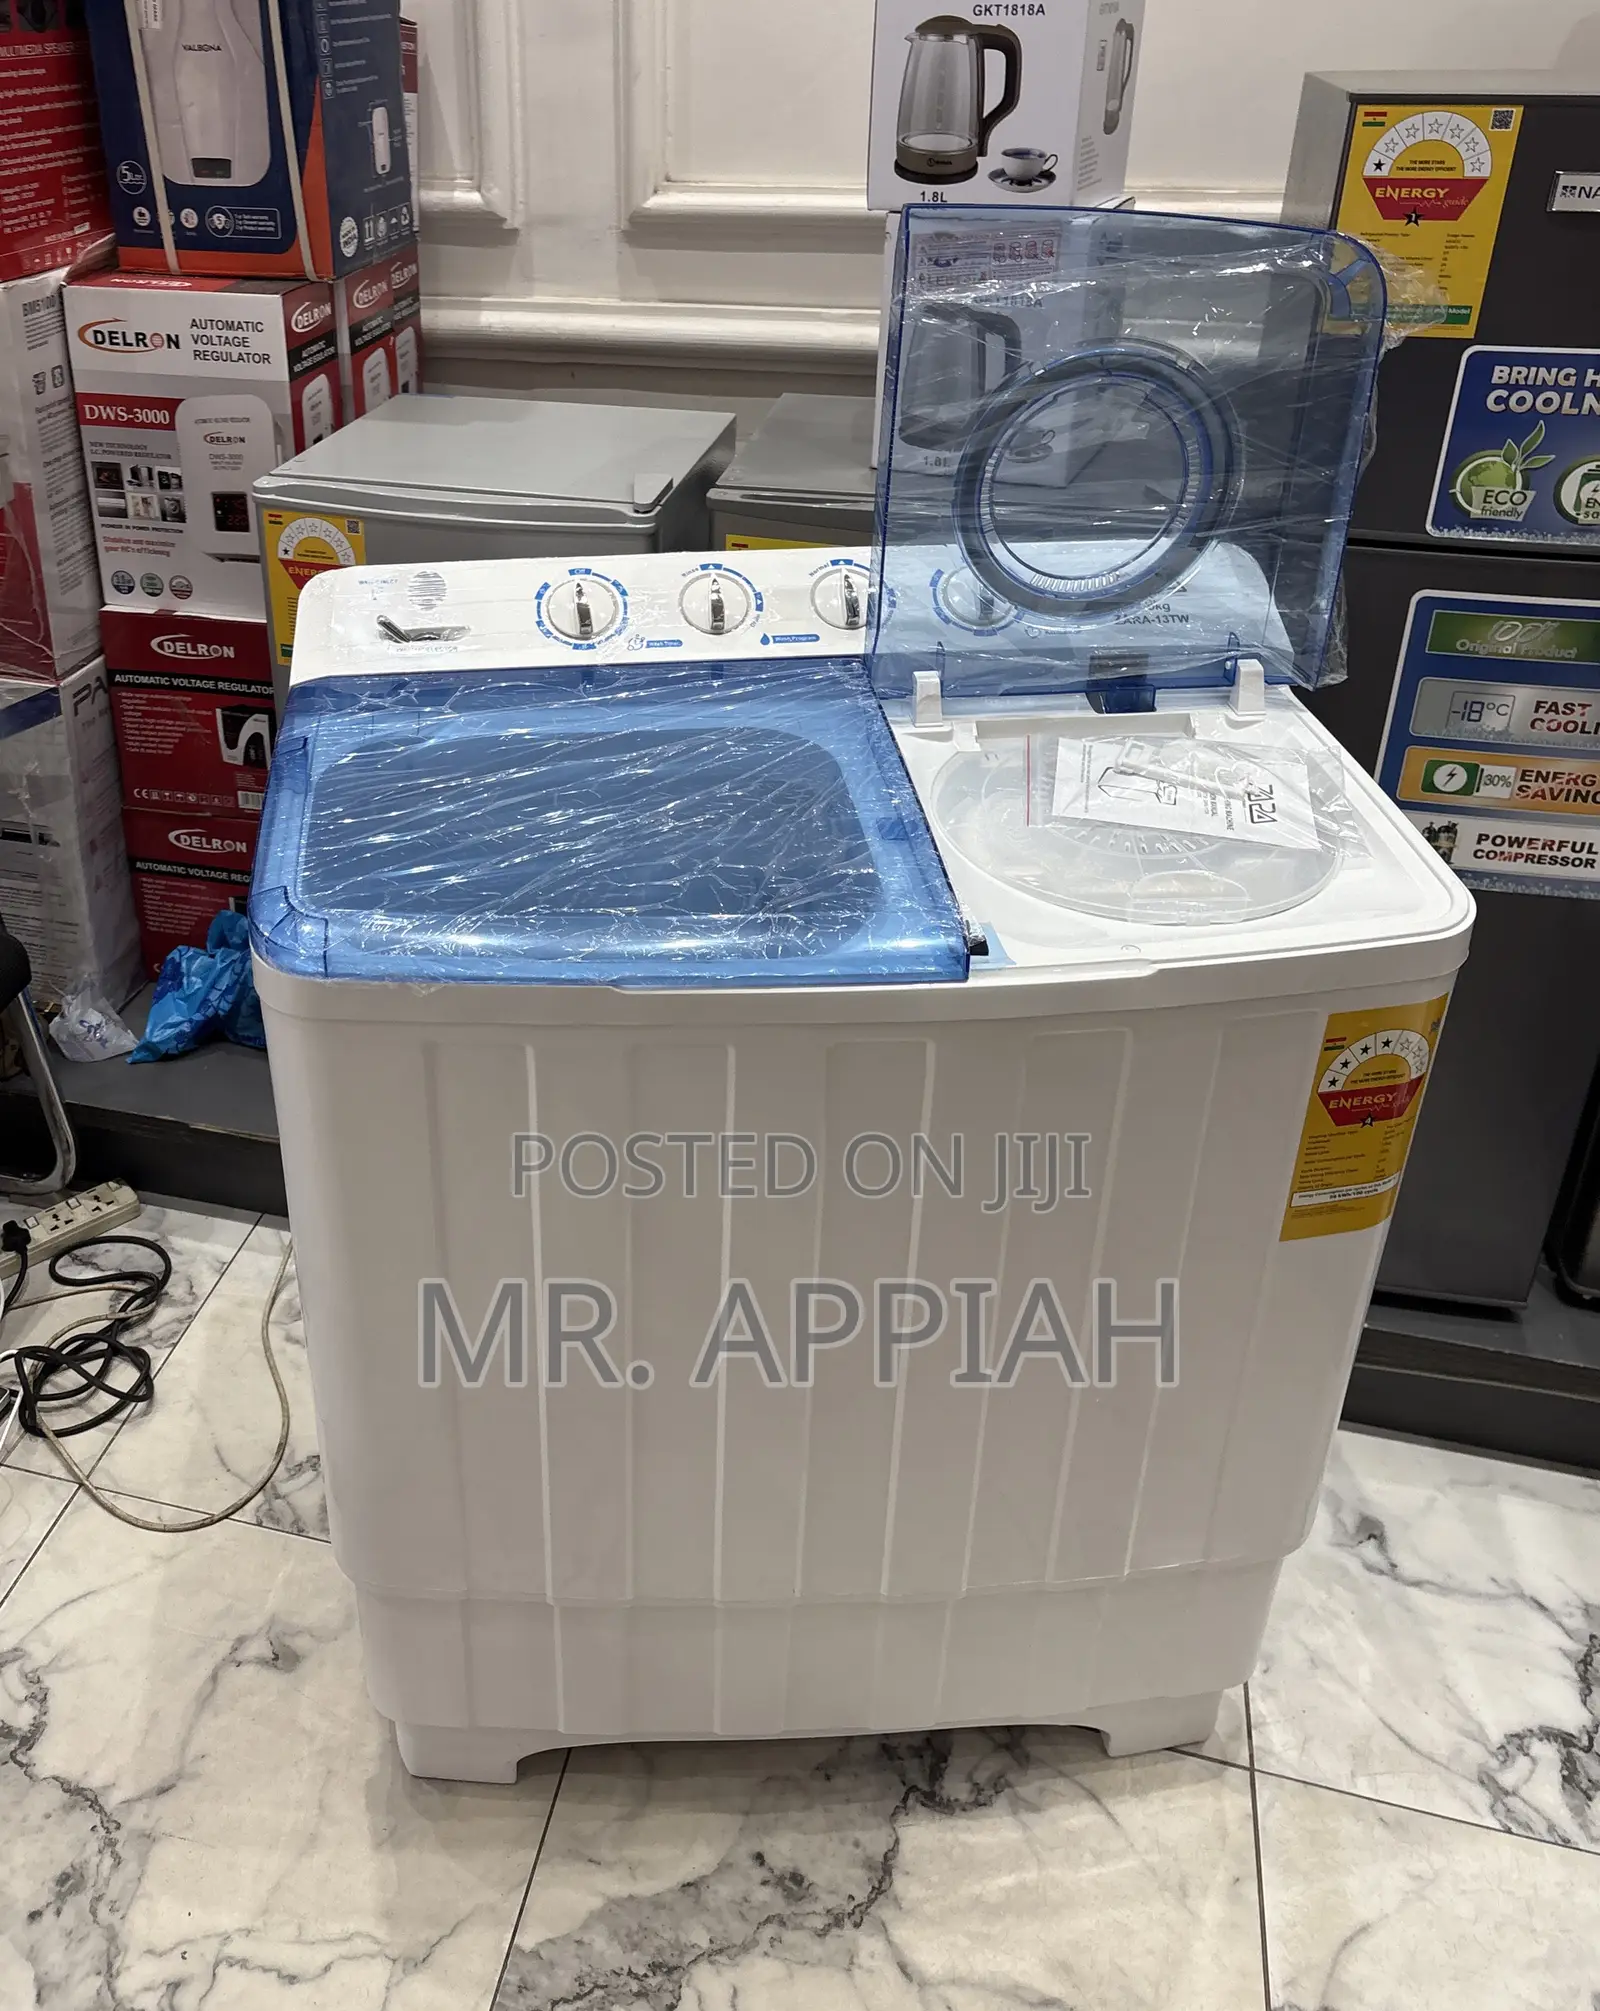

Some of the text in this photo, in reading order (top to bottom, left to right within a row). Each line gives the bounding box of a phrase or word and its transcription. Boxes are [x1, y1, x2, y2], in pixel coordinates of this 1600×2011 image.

[972, 3, 1046, 16] GKT1818A
[121, 165, 131, 181] 5
[919, 191, 948, 202] 1.8L
[1374, 185, 1450, 200] ENERGY
[1410, 213, 1416, 221] 1
[358, 281, 388, 304] DELRON
[296, 302, 332, 329] DELRON
[1448, 307, 1471, 315] Model
[190, 318, 264, 333] AUTOMATIC
[92, 329, 181, 350] DELRON
[190, 334, 250, 348] VOLTAGE
[193, 350, 272, 365] REGULATOR
[1491, 365, 1577, 387] BRING
[83, 404, 171, 425] DWS-3000
[209, 436, 246, 444] DELRON
[1482, 489, 1528, 506] ECO
[1480, 505, 1524, 520] friendly
[681, 566, 699, 578] Rinse
[808, 562, 830, 578] Normal
[1487, 620, 1560, 644] 100%
[163, 641, 235, 659] DELRON
[1455, 638, 1578, 659] Original Product
[114, 674, 170, 686] AUTOMATIC
[171, 677, 217, 690] VOLTAGE
[1533, 700, 1593, 716] FAST
[1483, 773, 1512, 788] 30%
[179, 834, 248, 853] DELRON
[1475, 832, 1600, 855] POWERFUL
[1472, 848, 1597, 869] COMPRESSOR
[136, 861, 187, 875] AUTOMATIC
[187, 867, 229, 880] VOLTAGE
[1328, 1092, 1398, 1109] ENERGY
[1364, 1117, 1372, 1125] 4
